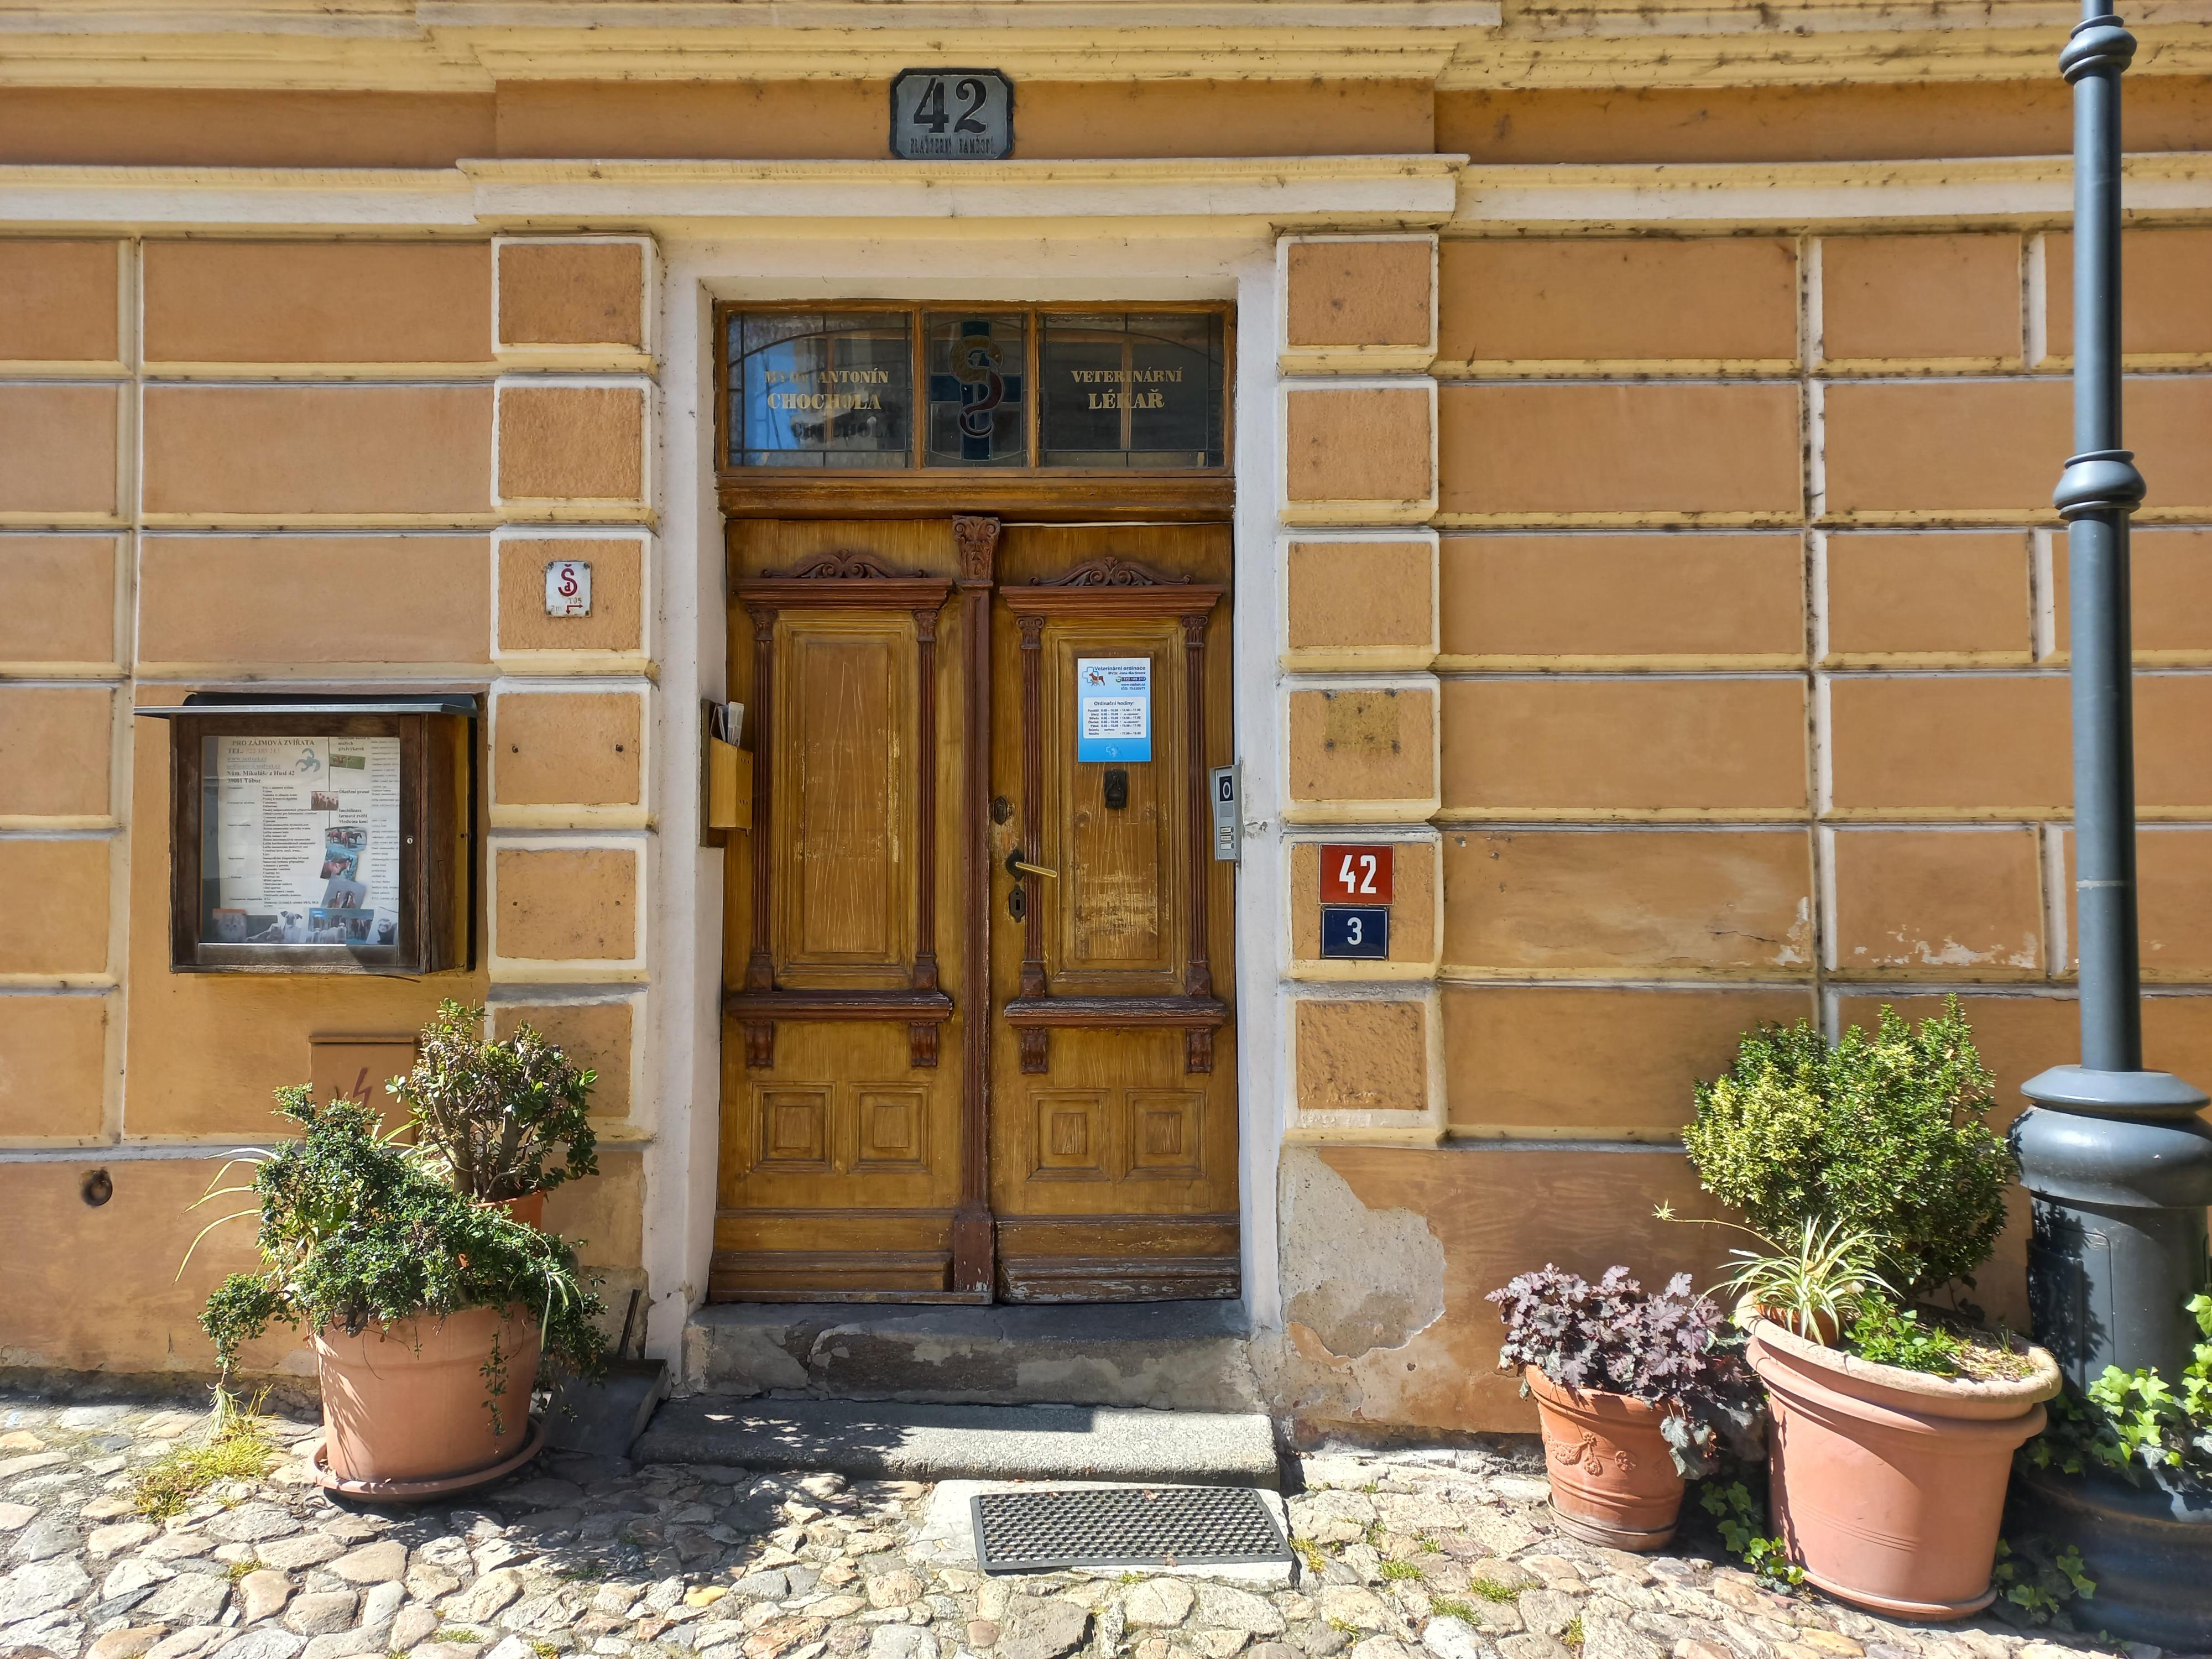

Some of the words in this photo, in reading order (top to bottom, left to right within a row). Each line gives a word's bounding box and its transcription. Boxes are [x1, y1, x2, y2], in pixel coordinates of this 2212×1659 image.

[914, 78, 987, 133] 42
[818, 368, 889, 383] ANTONÍN
[1071, 367, 1182, 383] VETERINÁRNÍ
[767, 393, 881, 410] CHOCHOLA
[1088, 389, 1165, 409] LÉKAŘ
[1339, 854, 1376, 894] 42
[1347, 917, 1362, 945] 3
